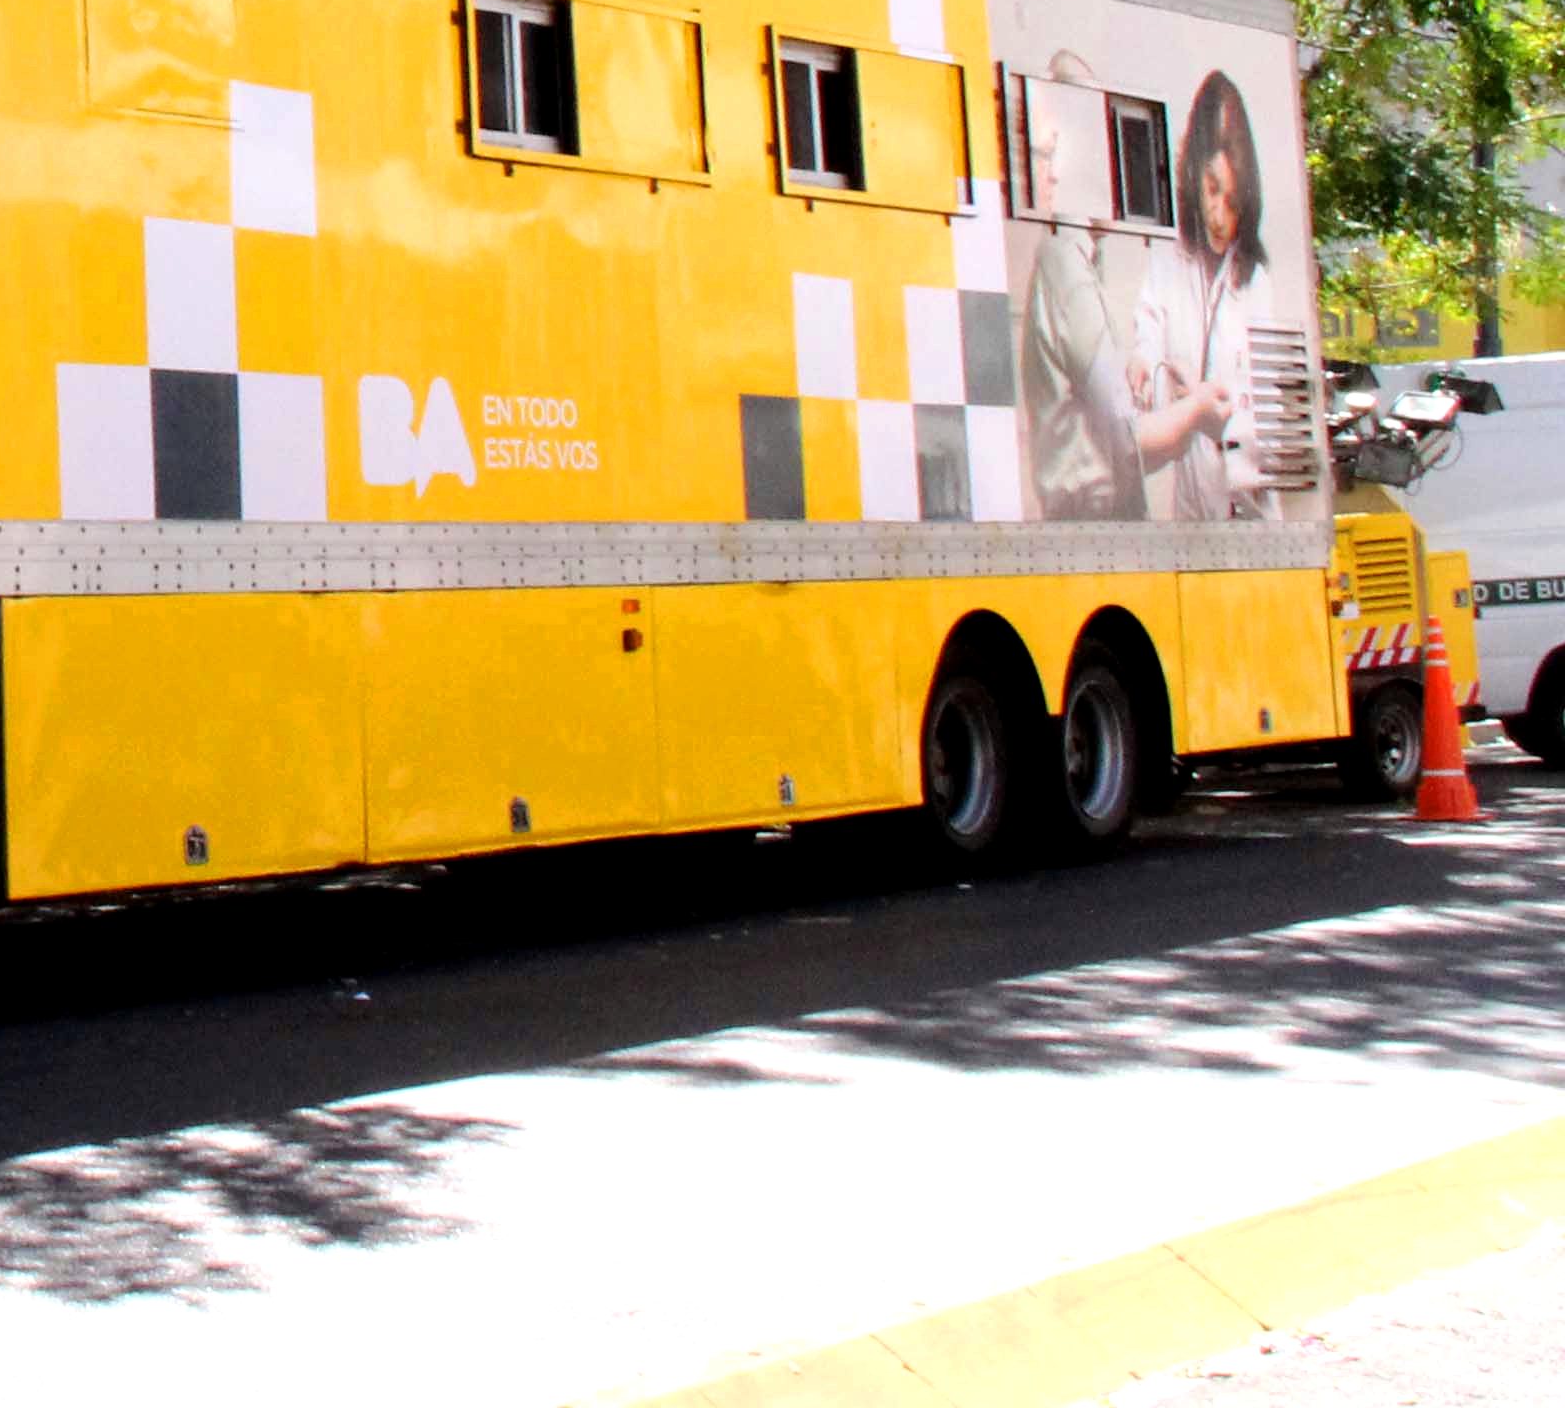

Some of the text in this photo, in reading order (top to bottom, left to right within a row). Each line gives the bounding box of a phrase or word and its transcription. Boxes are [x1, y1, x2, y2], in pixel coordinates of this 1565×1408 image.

[483, 396, 577, 427] EN TODO
[358, 375, 477, 498] BA
[484, 433, 598, 470] ESTÁS VOS
[1499, 580, 1531, 601] DE
